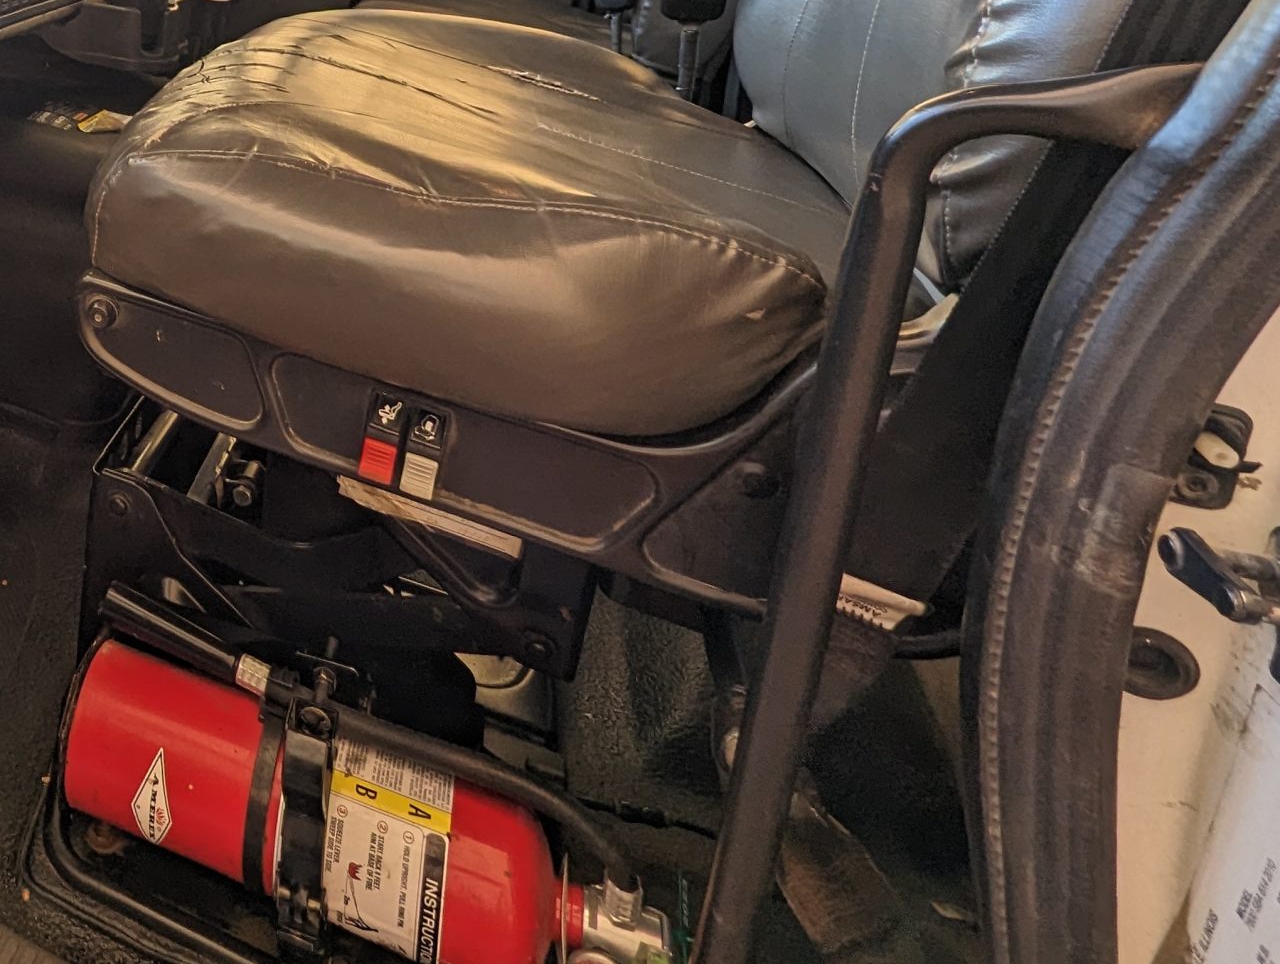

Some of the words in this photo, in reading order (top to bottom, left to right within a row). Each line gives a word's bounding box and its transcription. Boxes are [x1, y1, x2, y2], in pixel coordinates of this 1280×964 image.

[355, 784, 378, 800] B
[148, 774, 160, 840] AMEREX
[408, 804, 432, 820] A
[328, 816, 338, 837] SWEEP
[335, 818, 345, 845] SQUEEZE
[326, 836, 335, 851] SIDE
[376, 835, 385, 854] START
[367, 853, 375, 869] BASE
[402, 845, 411, 862] HOLD
[375, 854, 383, 871] BACK
